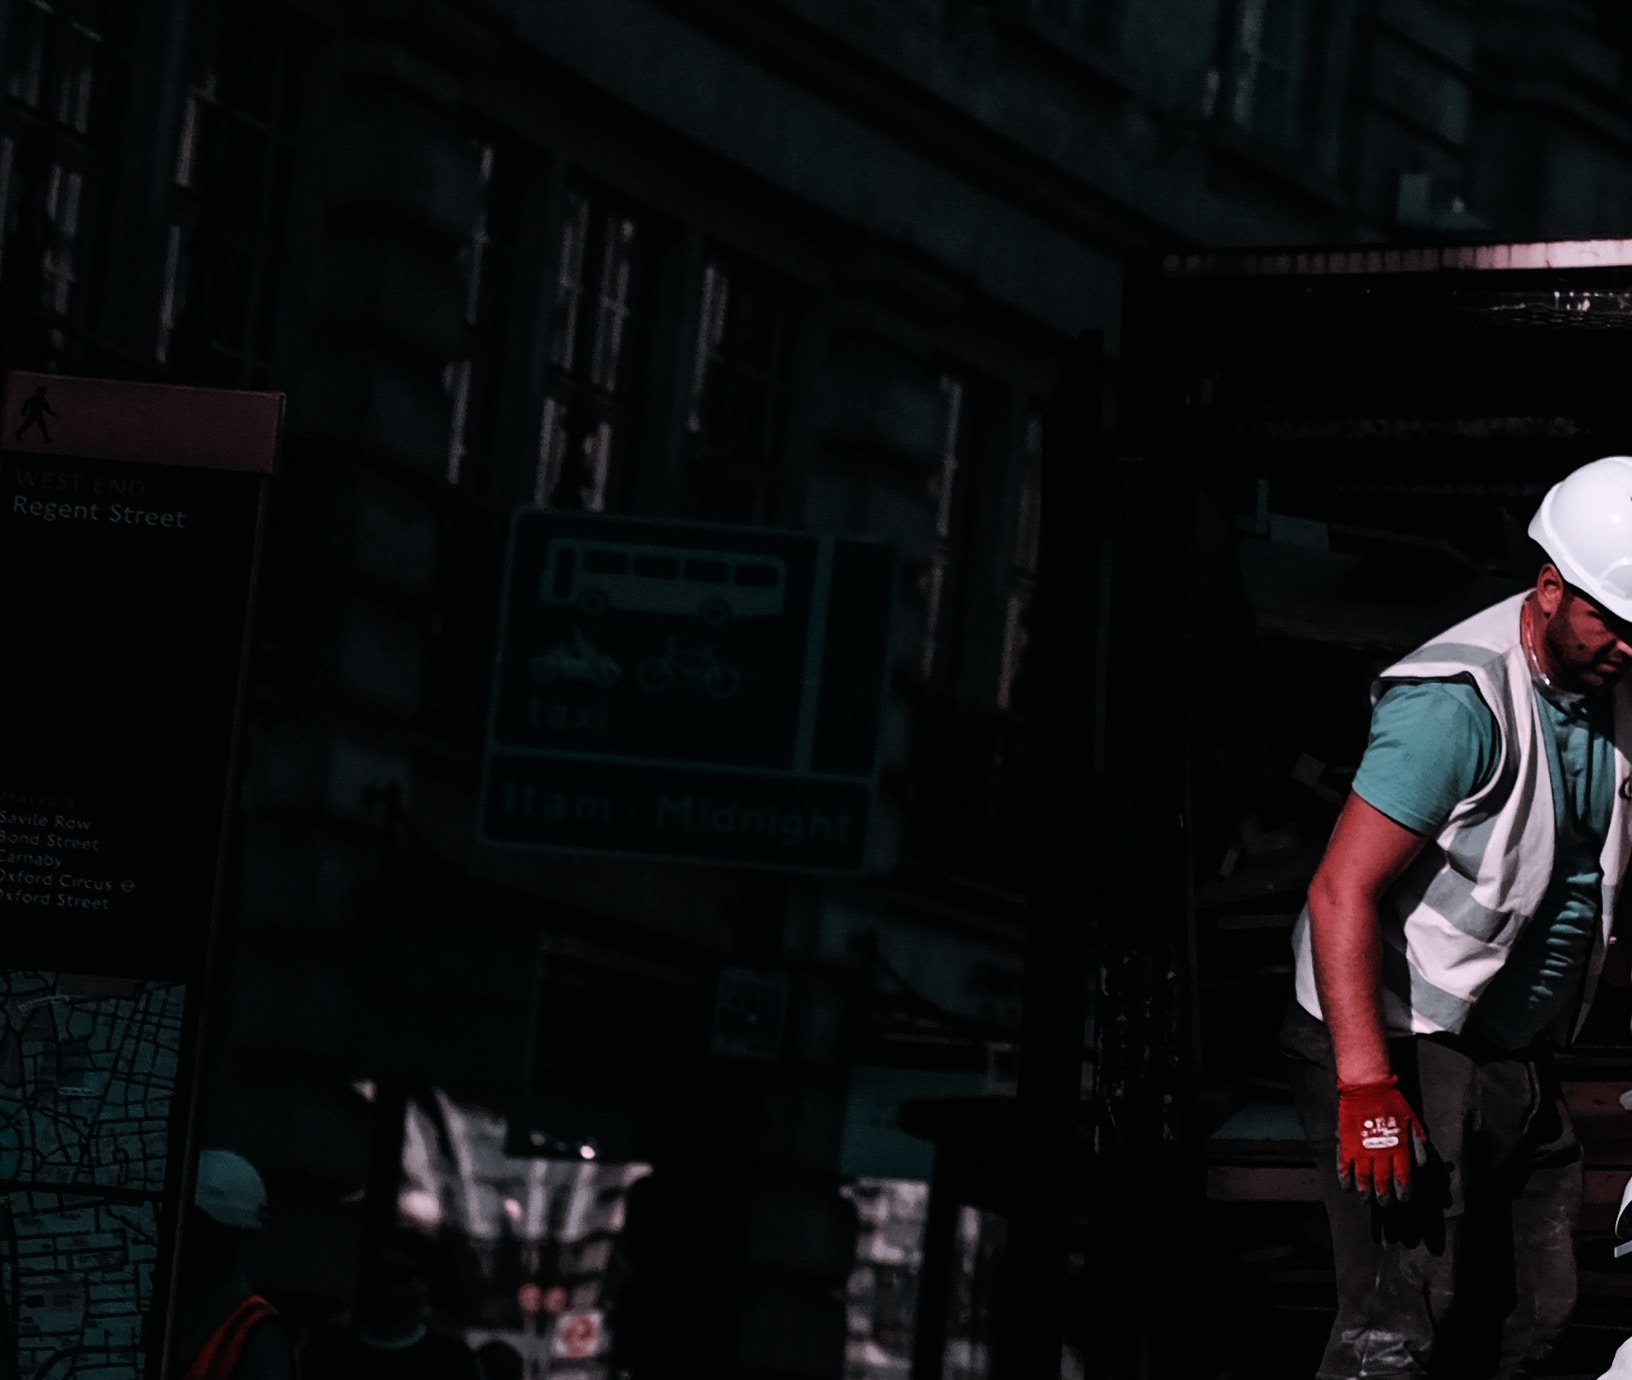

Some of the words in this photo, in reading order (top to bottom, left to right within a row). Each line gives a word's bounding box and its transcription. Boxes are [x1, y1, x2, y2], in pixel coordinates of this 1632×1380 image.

[15, 469, 82, 492] WEST
[93, 475, 145, 498] END
[12, 495, 100, 521] Regent
[109, 503, 187, 529] Street
[527, 695, 608, 734] taxi
[0, 810, 49, 827] Savile
[54, 814, 92, 831] Row
[501, 782, 613, 823] 11am
[655, 792, 854, 848] Midnight
[0, 830, 40, 846] Bond
[47, 833, 100, 851] Street
[59, 874, 113, 891] Circus
[57, 892, 111, 911] Street
